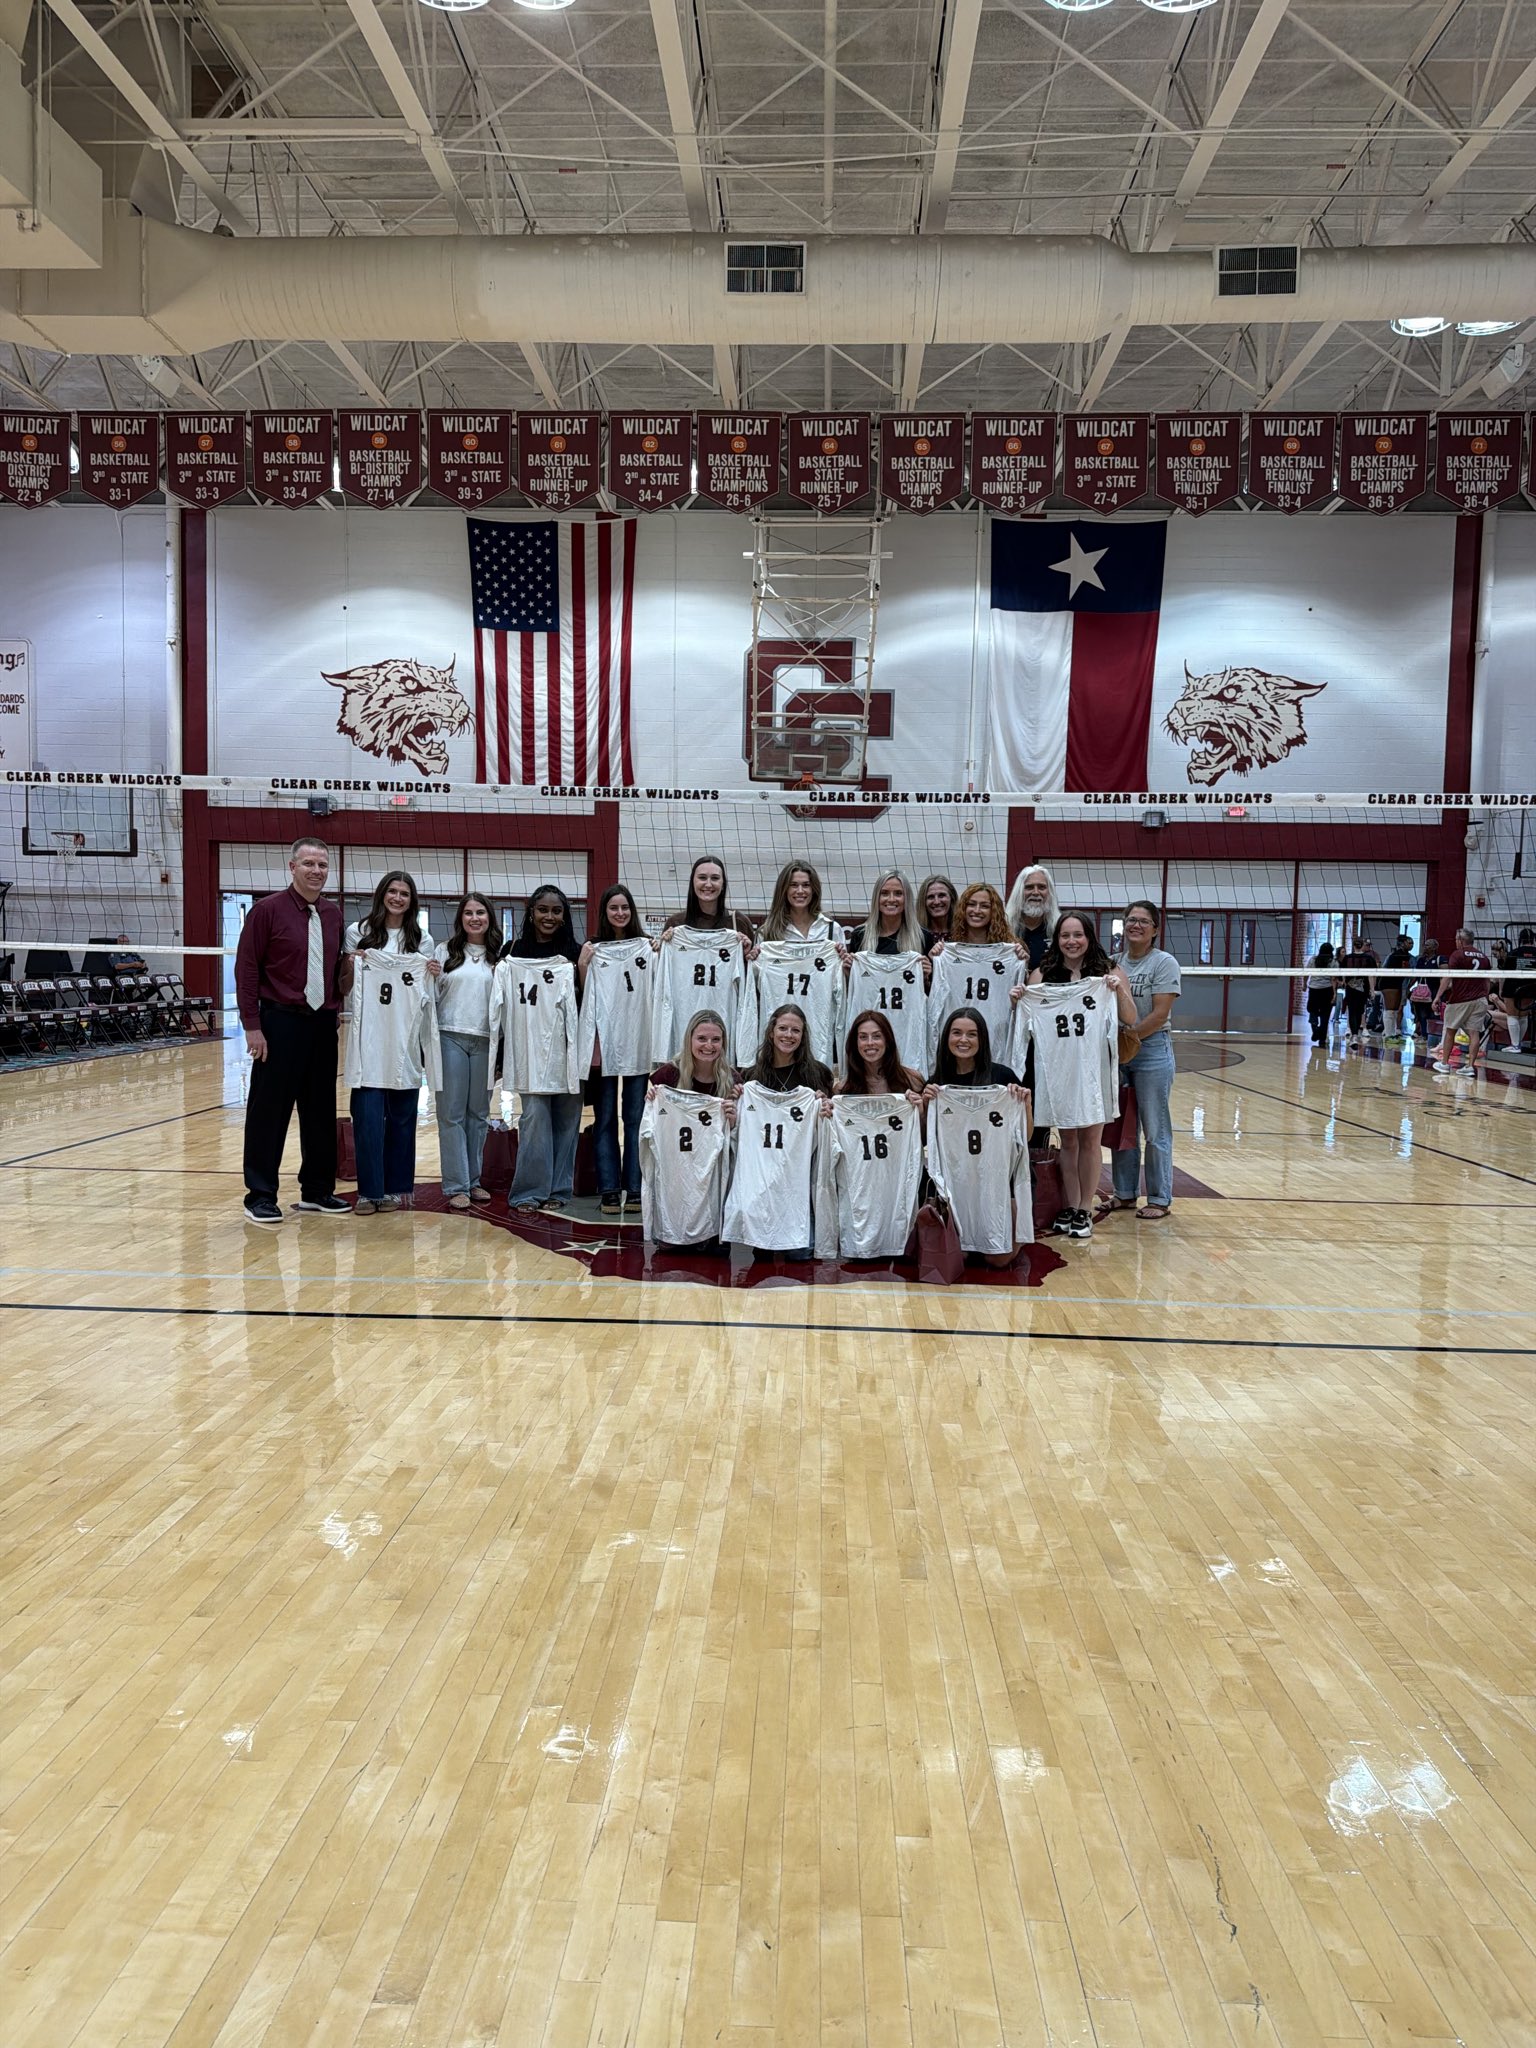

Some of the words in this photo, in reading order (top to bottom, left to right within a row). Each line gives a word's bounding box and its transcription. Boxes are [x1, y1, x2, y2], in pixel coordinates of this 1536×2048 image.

[4, 417, 60, 434] WILDCAT
[91, 419, 147, 434] WILDCAT
[179, 418, 234, 434] WILDCAT
[265, 417, 321, 433] WILDCAT
[351, 415, 407, 431] WILDCAT
[442, 417, 499, 432] WILDCAT
[531, 419, 588, 434] WILDCAT
[623, 419, 680, 434] WILDCAT
[712, 418, 769, 435] WILDCAT
[802, 419, 859, 436] WILDCAT
[894, 421, 952, 436] WILDCAT
[986, 420, 1044, 436] WILDCAT
[1077, 421, 1136, 437] WILDCAT
[1170, 421, 1228, 437] WILDCAT
[1264, 420, 1323, 436] WILDCAT
[1355, 419, 1416, 435] WILDCAT
[1450, 420, 1510, 436] WILDCAT
[0, 452, 61, 465] BASKETBALL
[90, 453, 150, 465] BASKETBALL
[177, 453, 238, 465] BASKETBALL
[264, 452, 325, 464] BASKETBALL
[350, 450, 412, 462] BASKETBALL
[441, 452, 504, 464] BASKETBALL
[528, 454, 591, 466] BASKETBALL
[620, 454, 683, 466] BASKETBALL
[708, 454, 771, 466] BASKETBALL
[799, 456, 862, 468] BASKETBALL
[982, 456, 1046, 468] BASKETBALL
[1261, 456, 1325, 468] BASKETBALL
[1351, 455, 1418, 468] BASKETBALL
[1447, 456, 1512, 468] BASKETBALL
[351, 463, 410, 474] BI-DISTRICT
[892, 457, 954, 469] BASKETBALL
[1075, 457, 1139, 469] BASKETBALL
[1167, 456, 1231, 469] BASKETBALL
[8, 464, 52, 477] DISTRICT
[293, 470, 321, 482] STATE
[472, 470, 501, 482] STATE
[544, 467, 574, 479] STATE
[712, 467, 741, 479] STATE
[746, 468, 766, 479] AAA
[815, 468, 844, 481] STATE
[899, 470, 944, 482] DISTRICT
[997, 469, 1027, 481] STATE
[1174, 470, 1222, 481] REGIONAL
[1266, 469, 1314, 481] REGIONAL
[1351, 468, 1415, 481] BI-DISTRICT
[1447, 469, 1509, 480] BI-DISTRICT
[8, 476, 49, 489] CHAMPS
[121, 472, 148, 484] STATE
[206, 471, 235, 483] STATE
[361, 475, 401, 487] CHAMPS
[650, 473, 679, 485] STATE
[1106, 476, 1136, 487] STATE
[530, 479, 588, 491] RUNNER-UP
[711, 480, 768, 492] CHAMPIONS
[800, 481, 858, 493] RUNNER-UP
[900, 483, 942, 495] CHAMPS
[983, 482, 1042, 494] RUNNER-UP
[1175, 482, 1219, 495] FINALIST
[1268, 482, 1312, 494] FINALIST
[1360, 482, 1404, 494] CHAMPS
[1455, 482, 1498, 494] CHAMPS
[17, 490, 42, 502] 22-8
[110, 488, 130, 500] 33-1
[196, 487, 219, 499] 33-3
[283, 487, 307, 499] 33-4
[367, 489, 394, 500] 27-14
[458, 487, 482, 500] 39-3
[546, 493, 570, 505] 36-2
[639, 490, 662, 502] 34-4
[1094, 492, 1117, 505] 27-4
[727, 494, 751, 506] 26-6
[818, 495, 842, 507] 25-7
[910, 496, 934, 508] 26-4
[1001, 496, 1025, 508] 28-3
[1186, 497, 1207, 509] 35-1
[1278, 495, 1300, 508] 33-4
[1368, 496, 1394, 508] 36-3
[1464, 495, 1489, 508] 36-4
[7, 772, 51, 782] CLEAR
[58, 773, 104, 784] CREEK
[110, 774, 182, 785] WILDCATS
[271, 778, 317, 789] CLEAR
[324, 780, 371, 791] CREEK
[377, 781, 450, 793] WILDCATS
[541, 786, 586, 796] CLEAR
[593, 787, 640, 798] CREEK
[646, 789, 719, 800] WILDCATS
[809, 792, 856, 802] CLEAR
[862, 792, 909, 802] CREEK
[916, 793, 990, 803] WILDCATS
[1084, 794, 1132, 804] CLEAR
[1138, 794, 1188, 804] CREEK
[1195, 793, 1272, 803] WILDCATS
[1368, 794, 1417, 804] CLEAR
[1424, 794, 1473, 805] CREEK
[624, 971, 634, 992] 1
[694, 964, 716, 987] 21
[787, 973, 810, 995] 17
[965, 977, 989, 1000] 18
[380, 983, 392, 1005] 9
[519, 983, 538, 1005] 14
[880, 987, 902, 1009] 12
[1055, 1013, 1084, 1037] 23
[680, 1127, 692, 1151] 2
[763, 1123, 783, 1149] 11
[861, 1134, 887, 1160] 16
[968, 1130, 981, 1155] 8
